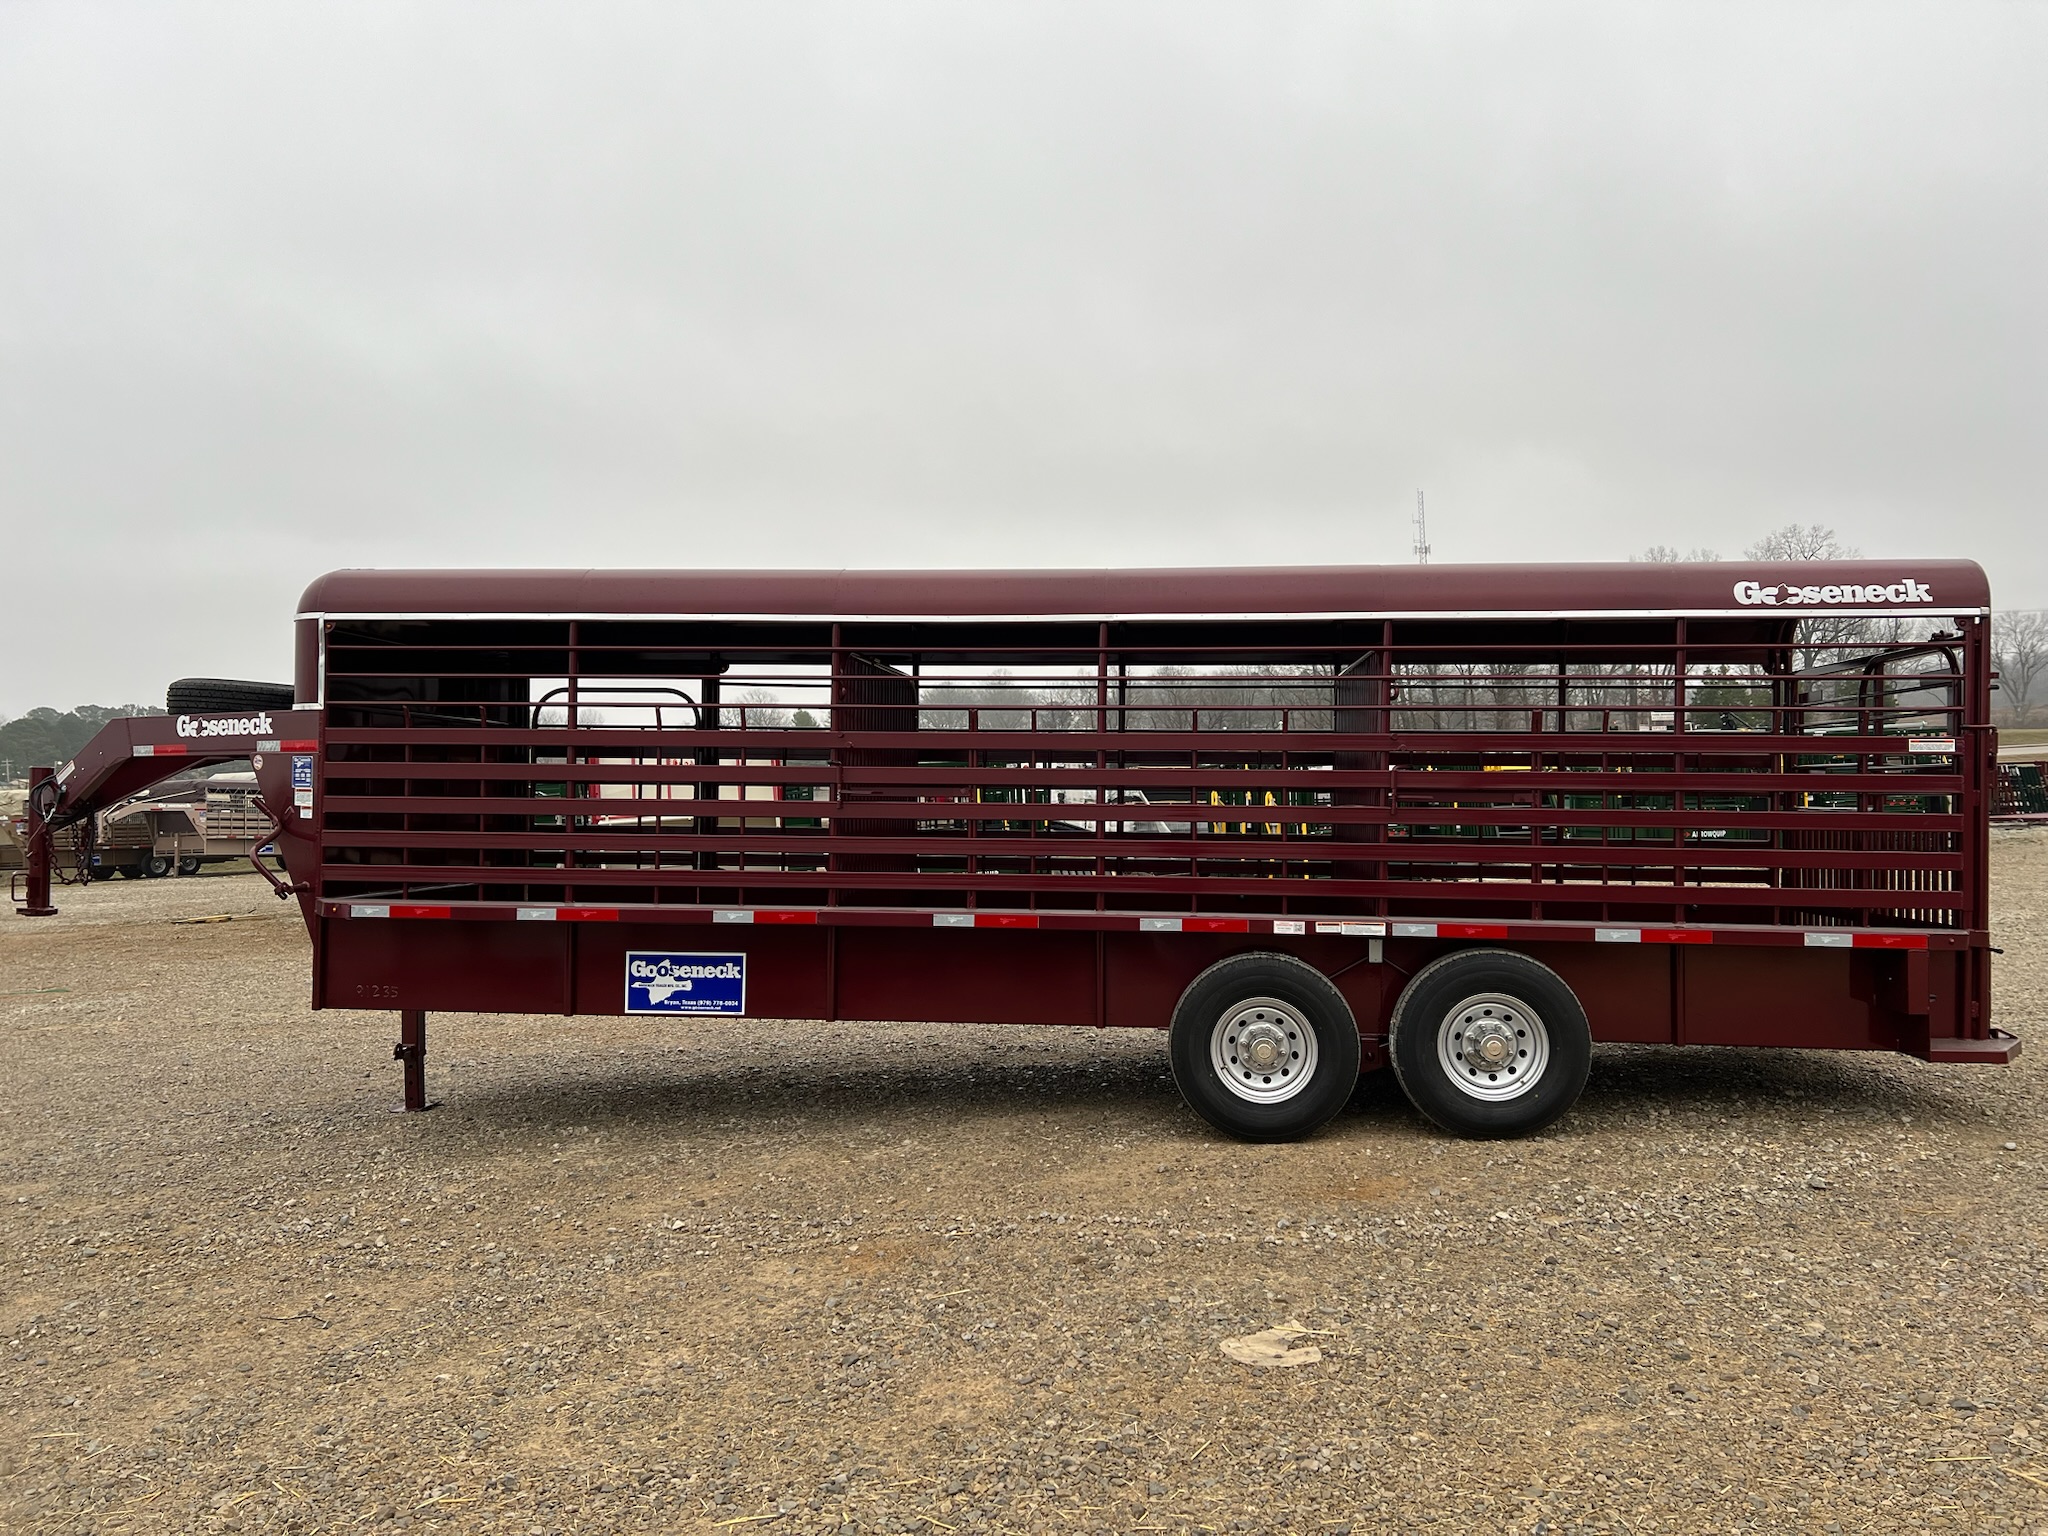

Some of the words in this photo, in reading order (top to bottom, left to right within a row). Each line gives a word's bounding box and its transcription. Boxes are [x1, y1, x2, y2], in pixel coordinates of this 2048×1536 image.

[1733, 579, 1933, 605] Gooseneck
[176, 712, 273, 737] Gooseneck
[630, 960, 741, 979] Gooseneck
